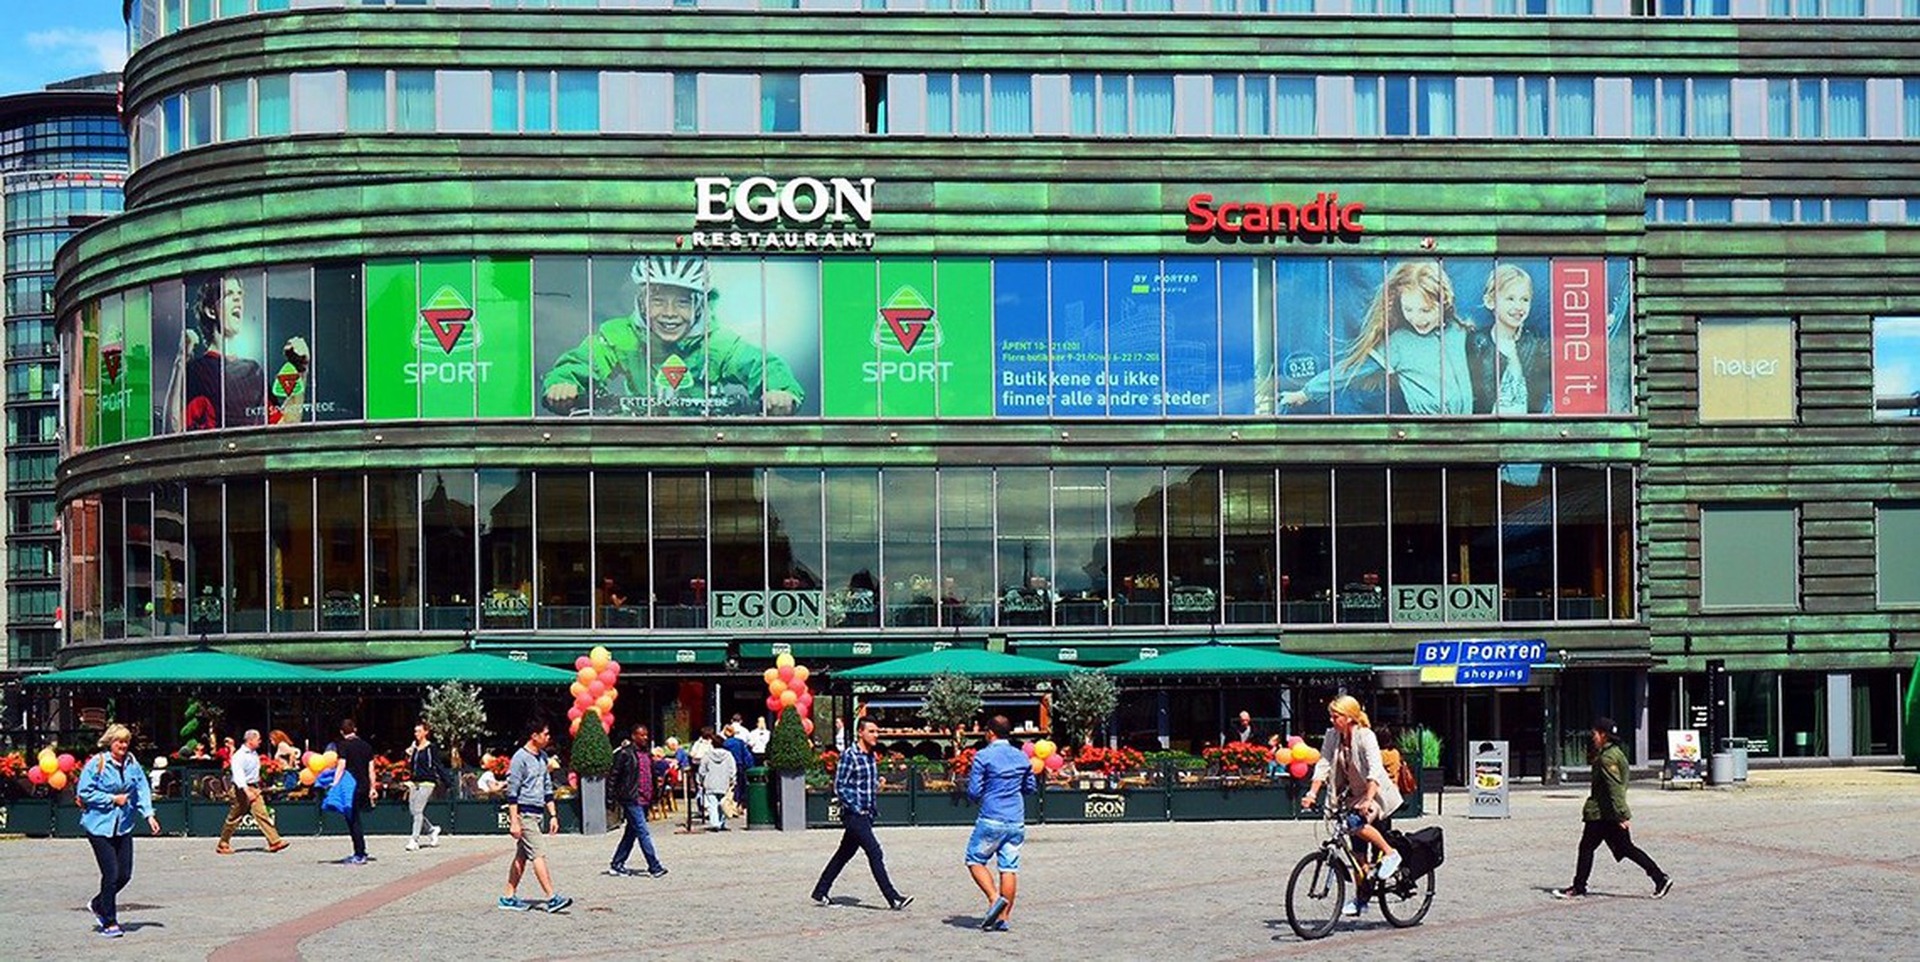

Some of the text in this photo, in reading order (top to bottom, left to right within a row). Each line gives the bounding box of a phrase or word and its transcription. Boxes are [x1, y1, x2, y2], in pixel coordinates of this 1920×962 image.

[694, 177, 876, 223] EGON
[1187, 192, 1365, 232] Scandic
[692, 232, 876, 247] RESTAURANT
[1563, 268, 1591, 361] name
[403, 362, 493, 384] SPORT
[862, 362, 954, 382] SPORT
[1003, 371, 1159, 386] Butikkene du ikke
[1002, 391, 1211, 406] finner alle andre steder
[715, 592, 820, 618] EGON
[1398, 587, 1493, 610] EGON
[1463, 669, 1524, 680] shopping
[1085, 802, 1125, 814] EGON
